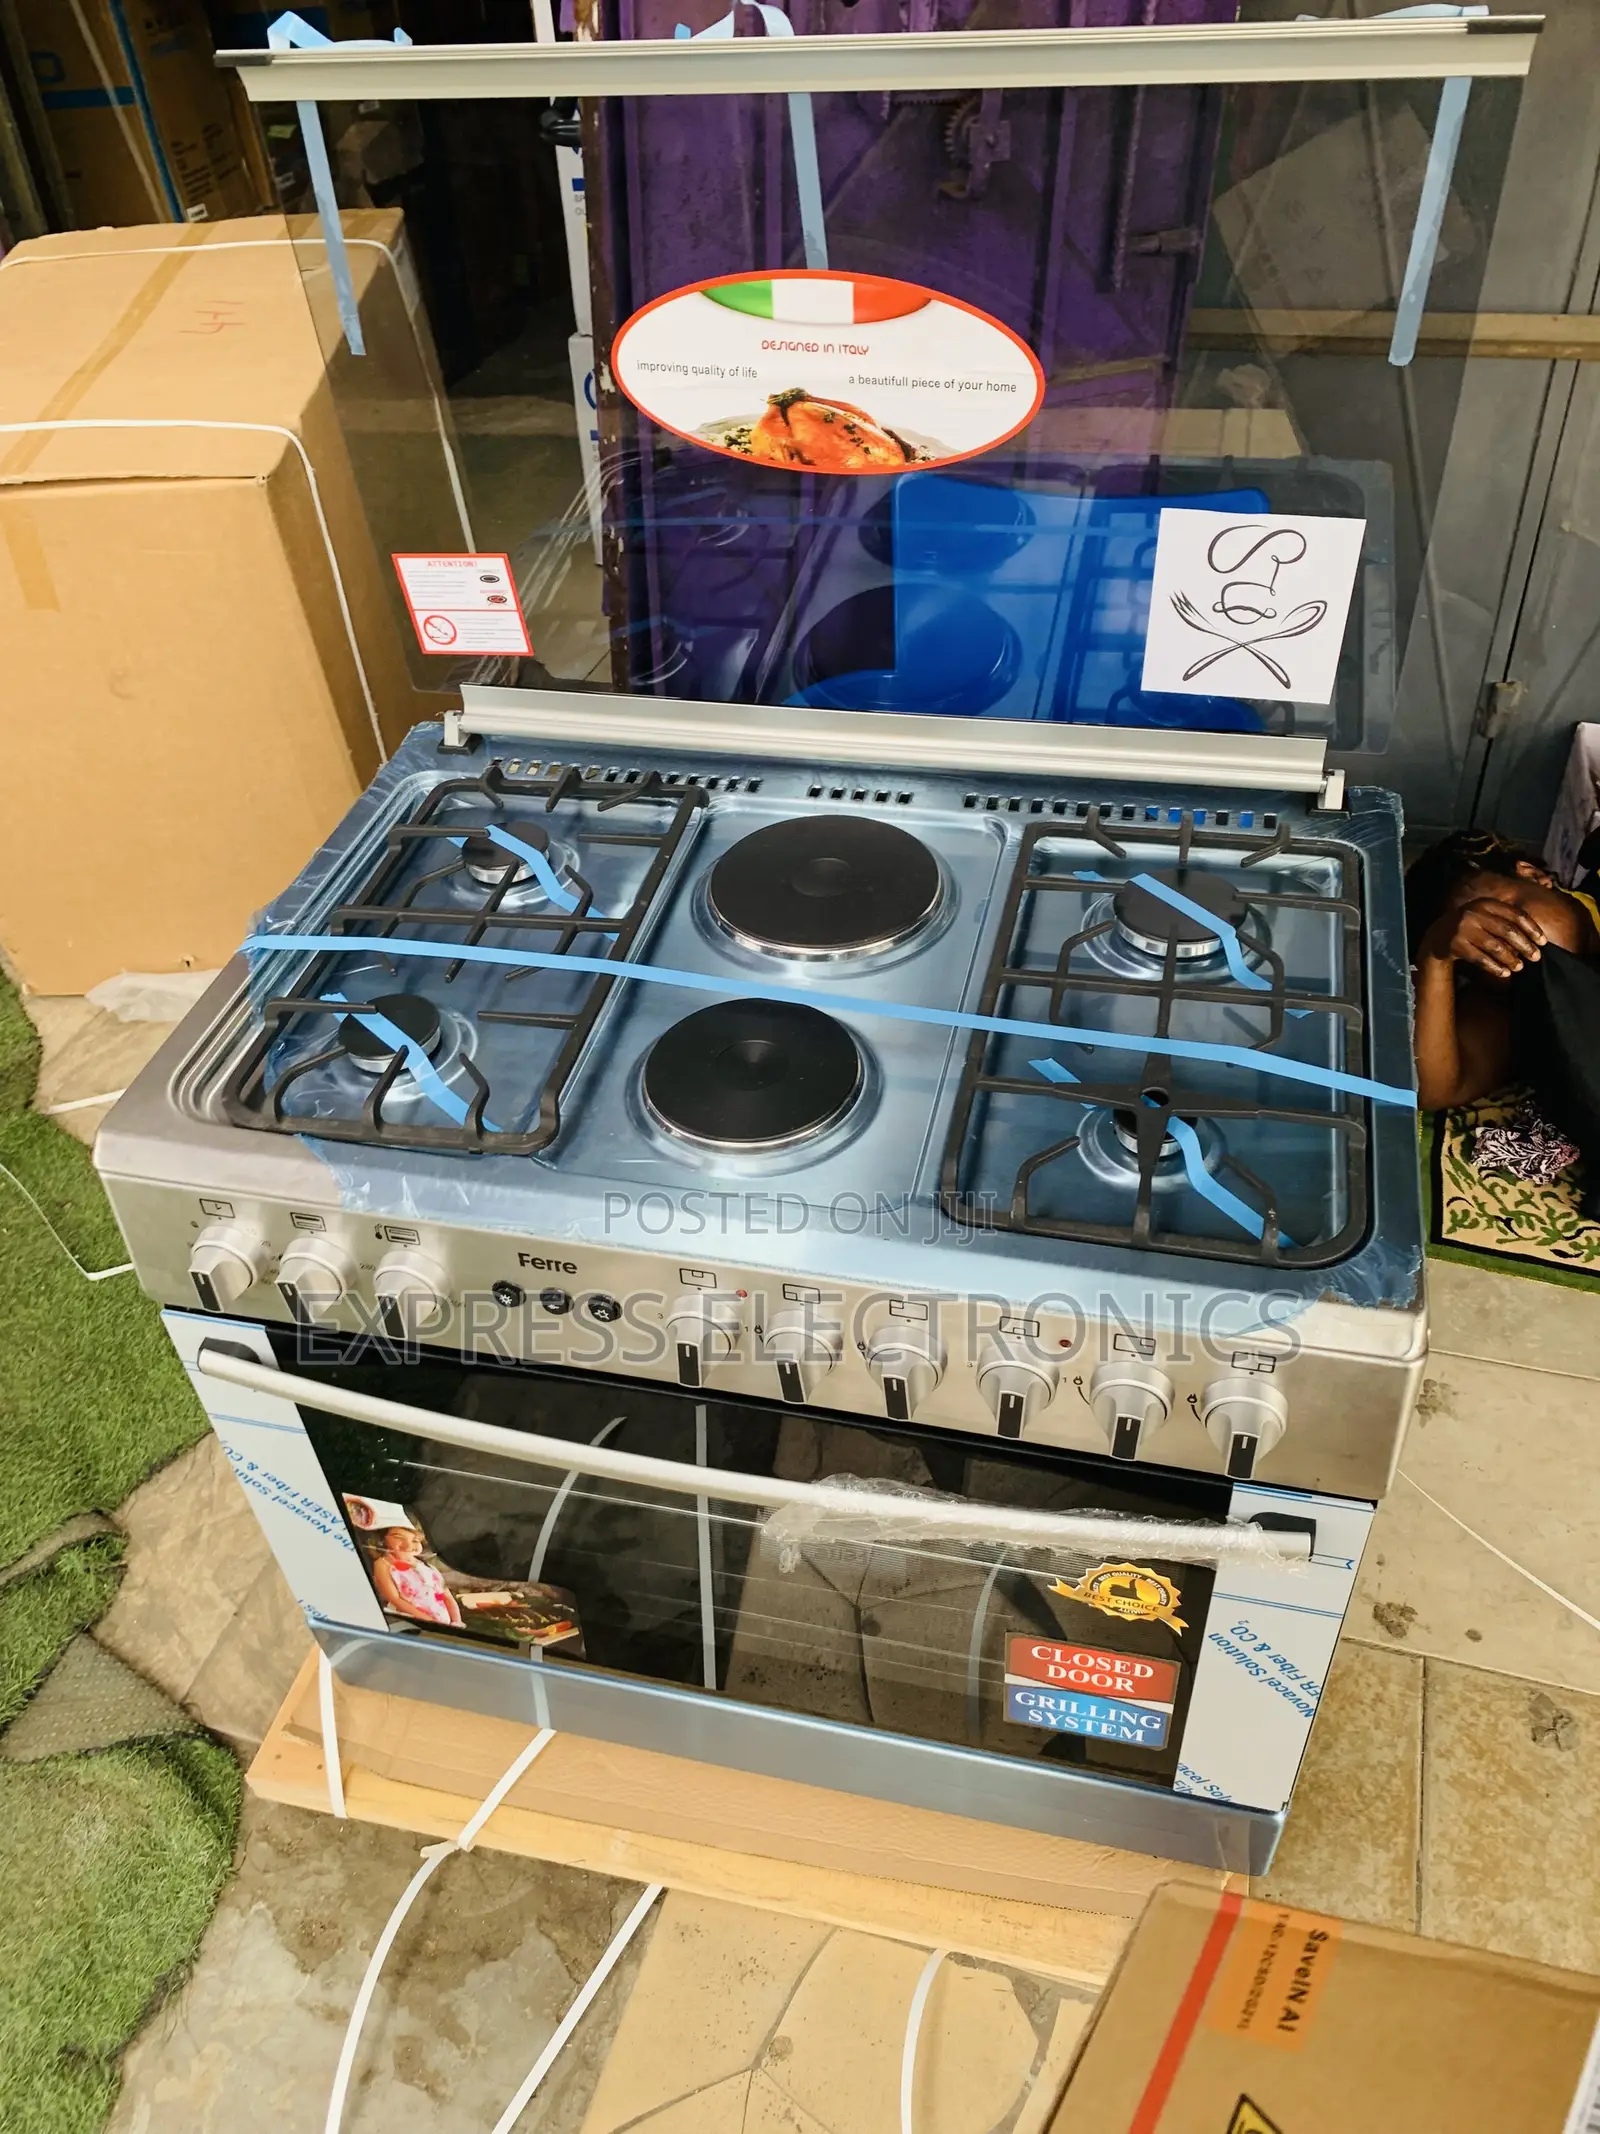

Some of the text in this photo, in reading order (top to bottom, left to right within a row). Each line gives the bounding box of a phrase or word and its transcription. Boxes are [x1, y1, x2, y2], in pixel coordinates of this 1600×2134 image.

[636, 360, 758, 378] improving quality of life
[848, 374, 1017, 393] a beautifull piece of your home
[517, 1252, 578, 1275] Ferre
[247, 1461, 259, 1471] &
[261, 1472, 300, 1498] Fiber
[271, 1495, 332, 1534] Novacel
[301, 1497, 347, 1531] ASER
[1083, 1592, 1160, 1613] BEST CHOICE
[1253, 1643, 1271, 1653] &
[1031, 1645, 1154, 1679] CLOSED
[1208, 1633, 1316, 1718] Novacel Solution
[1266, 1653, 1308, 1681] Fiber
[1047, 1664, 1136, 1693] DOOR
[1014, 1691, 1162, 1730] GRILLING
[1028, 1709, 1145, 1743] SYSTEM
[1177, 1762, 1211, 1784] acel
